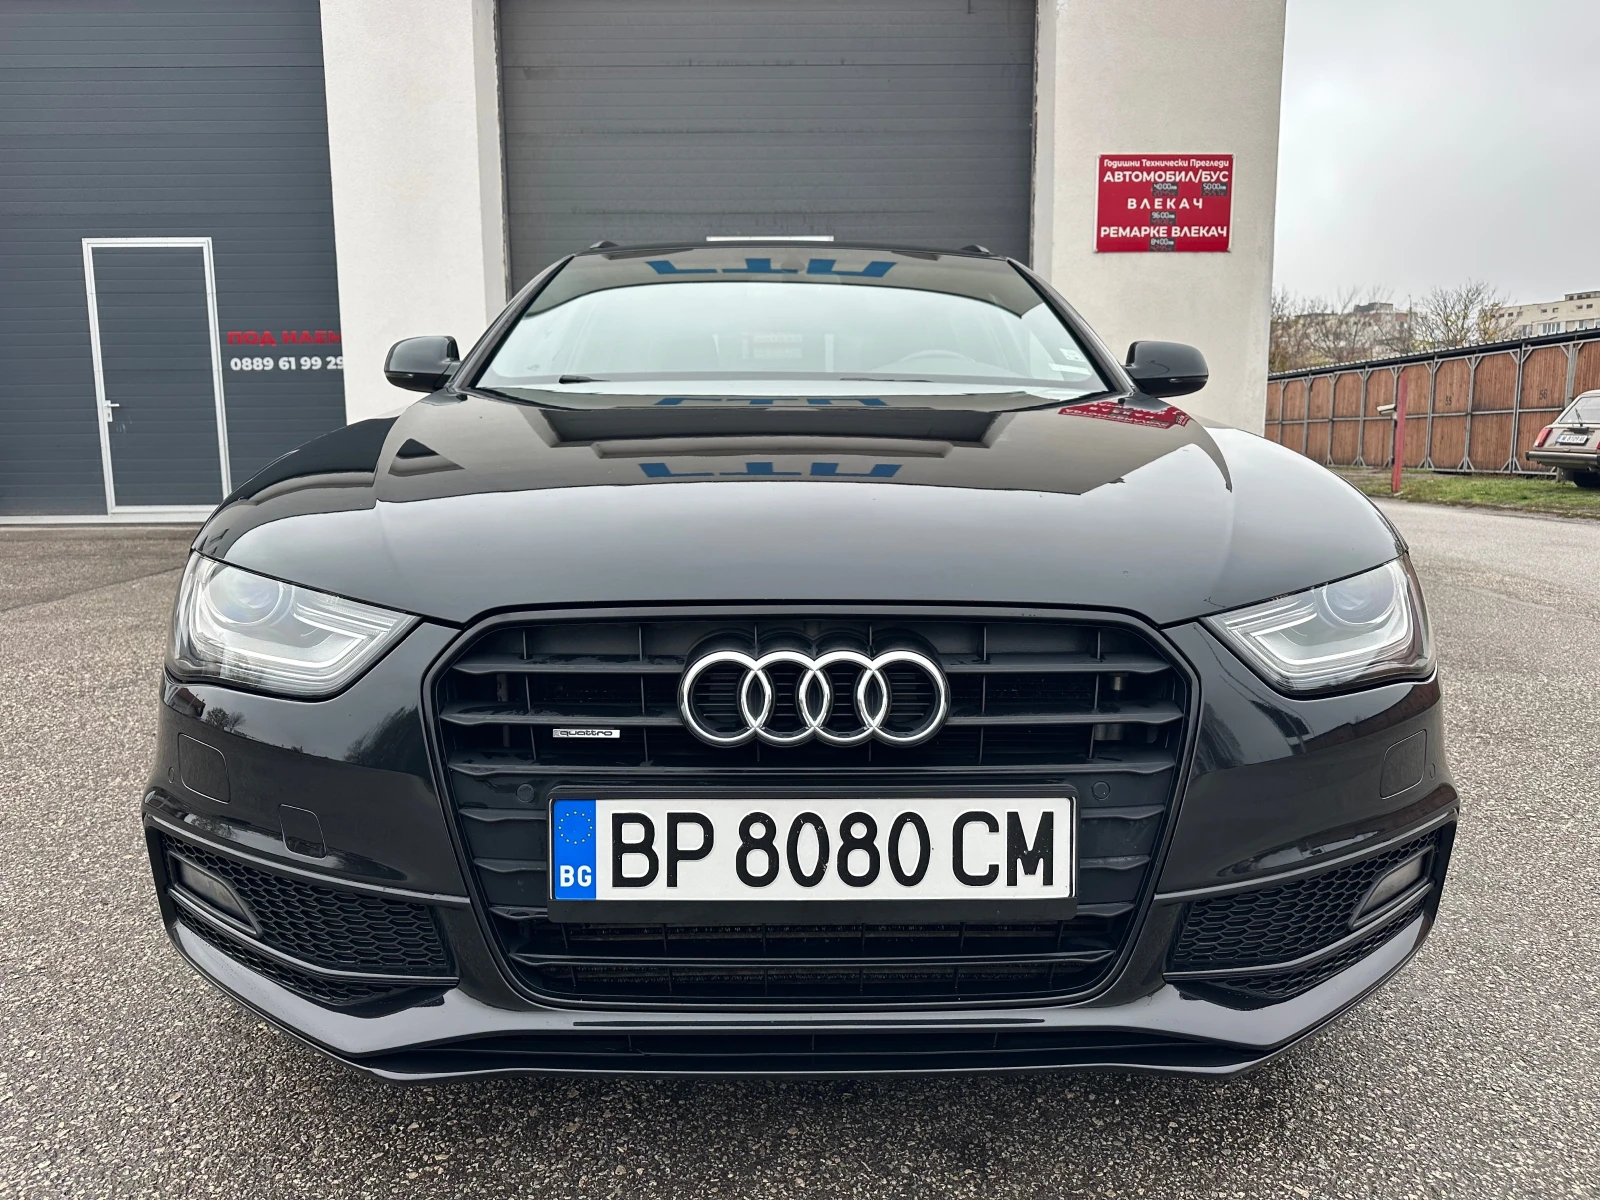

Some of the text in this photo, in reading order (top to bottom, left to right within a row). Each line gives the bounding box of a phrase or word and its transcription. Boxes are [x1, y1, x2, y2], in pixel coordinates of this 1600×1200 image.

[1104, 159, 1229, 168] Годишни Технически Прегледи
[1103, 169, 1229, 183] АВТОМОБИЛ/БУС
[1101, 226, 1227, 237] РЕМАРКЕ ВЛЕКАЧ
[227, 331, 277, 346] ПОД
[230, 357, 274, 371] 0889
[278, 357, 296, 370] 61
[300, 356, 322, 370] 99
[611, 811, 1054, 888] BP 8080 CM
[559, 865, 592, 887] BG
